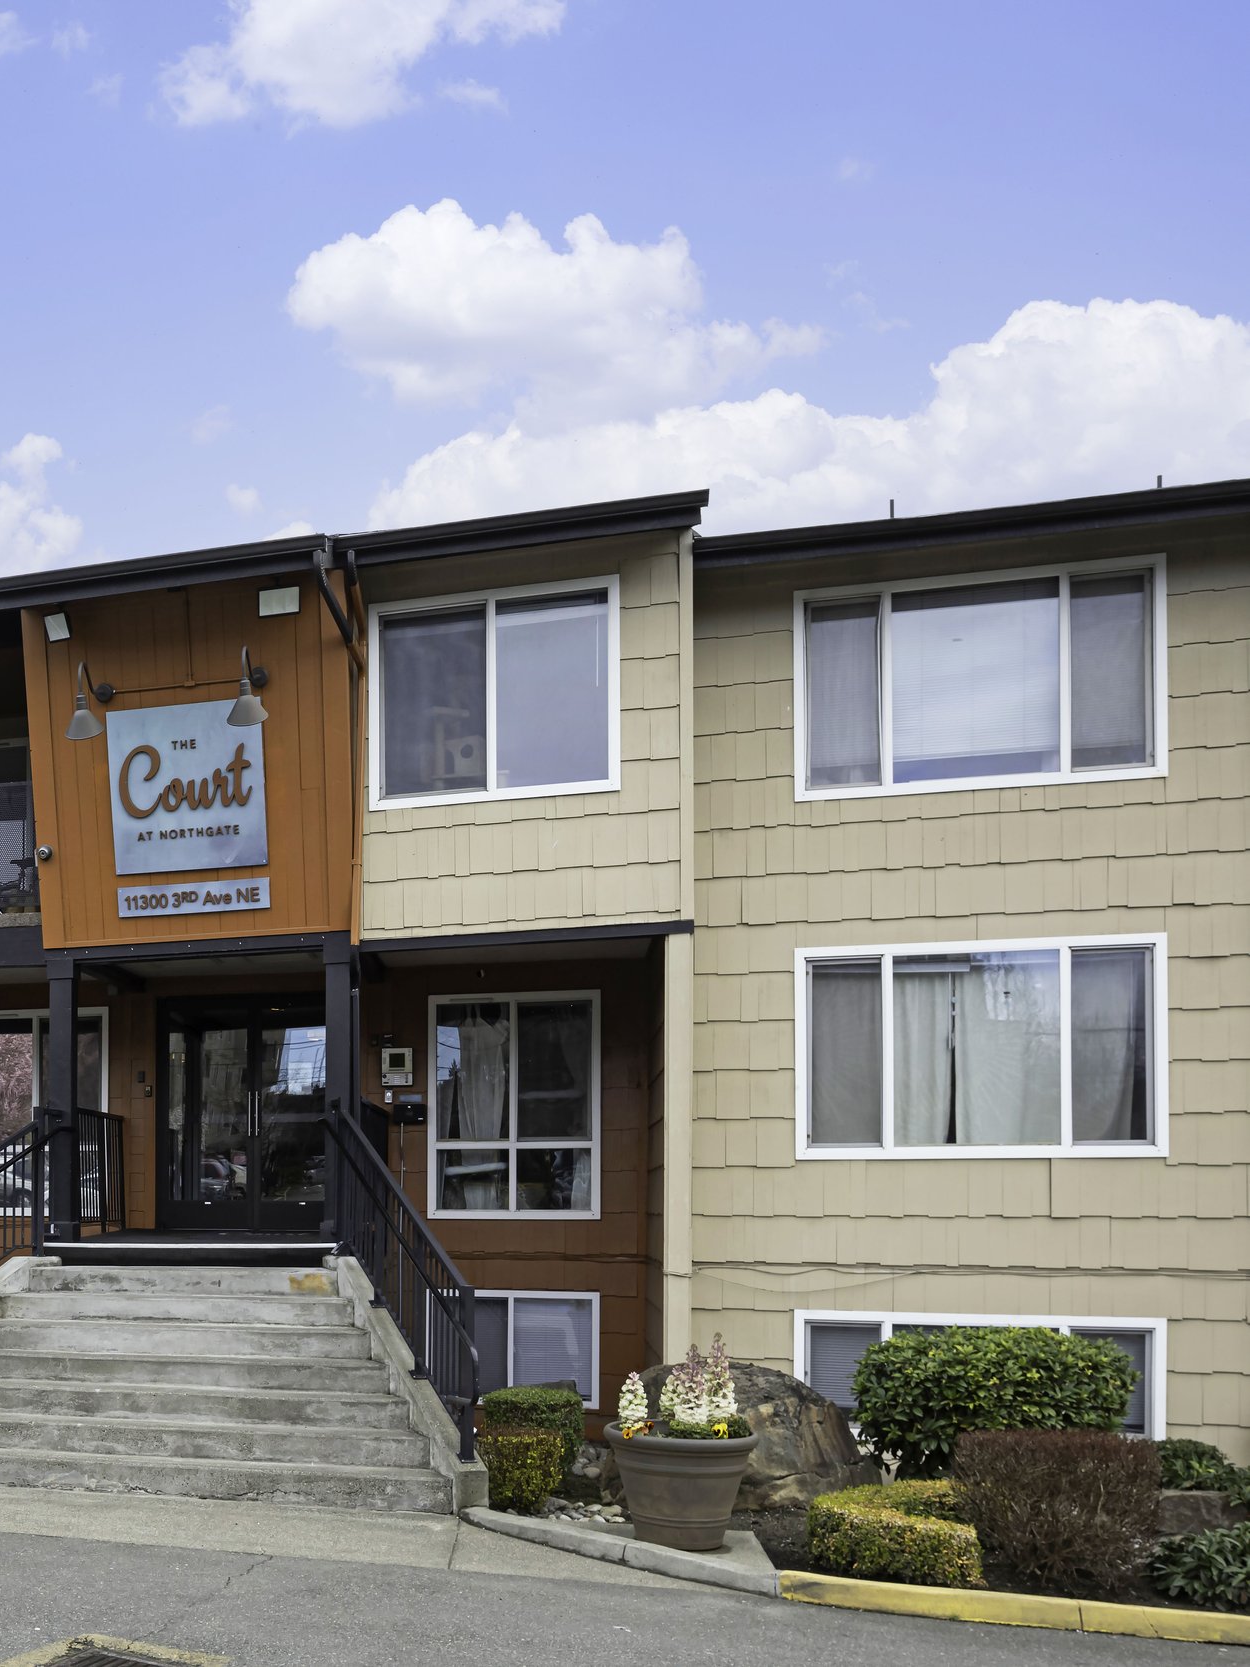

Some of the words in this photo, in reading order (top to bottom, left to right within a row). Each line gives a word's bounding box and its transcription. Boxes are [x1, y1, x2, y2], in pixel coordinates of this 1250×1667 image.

[171, 739, 197, 750] THE
[118, 742, 253, 819] Court
[137, 831, 153, 842] AT
[159, 824, 240, 840] NORTHGATE
[124, 893, 169, 911] 11300
[202, 890, 232, 906] Ave
[236, 886, 261, 903] NE
